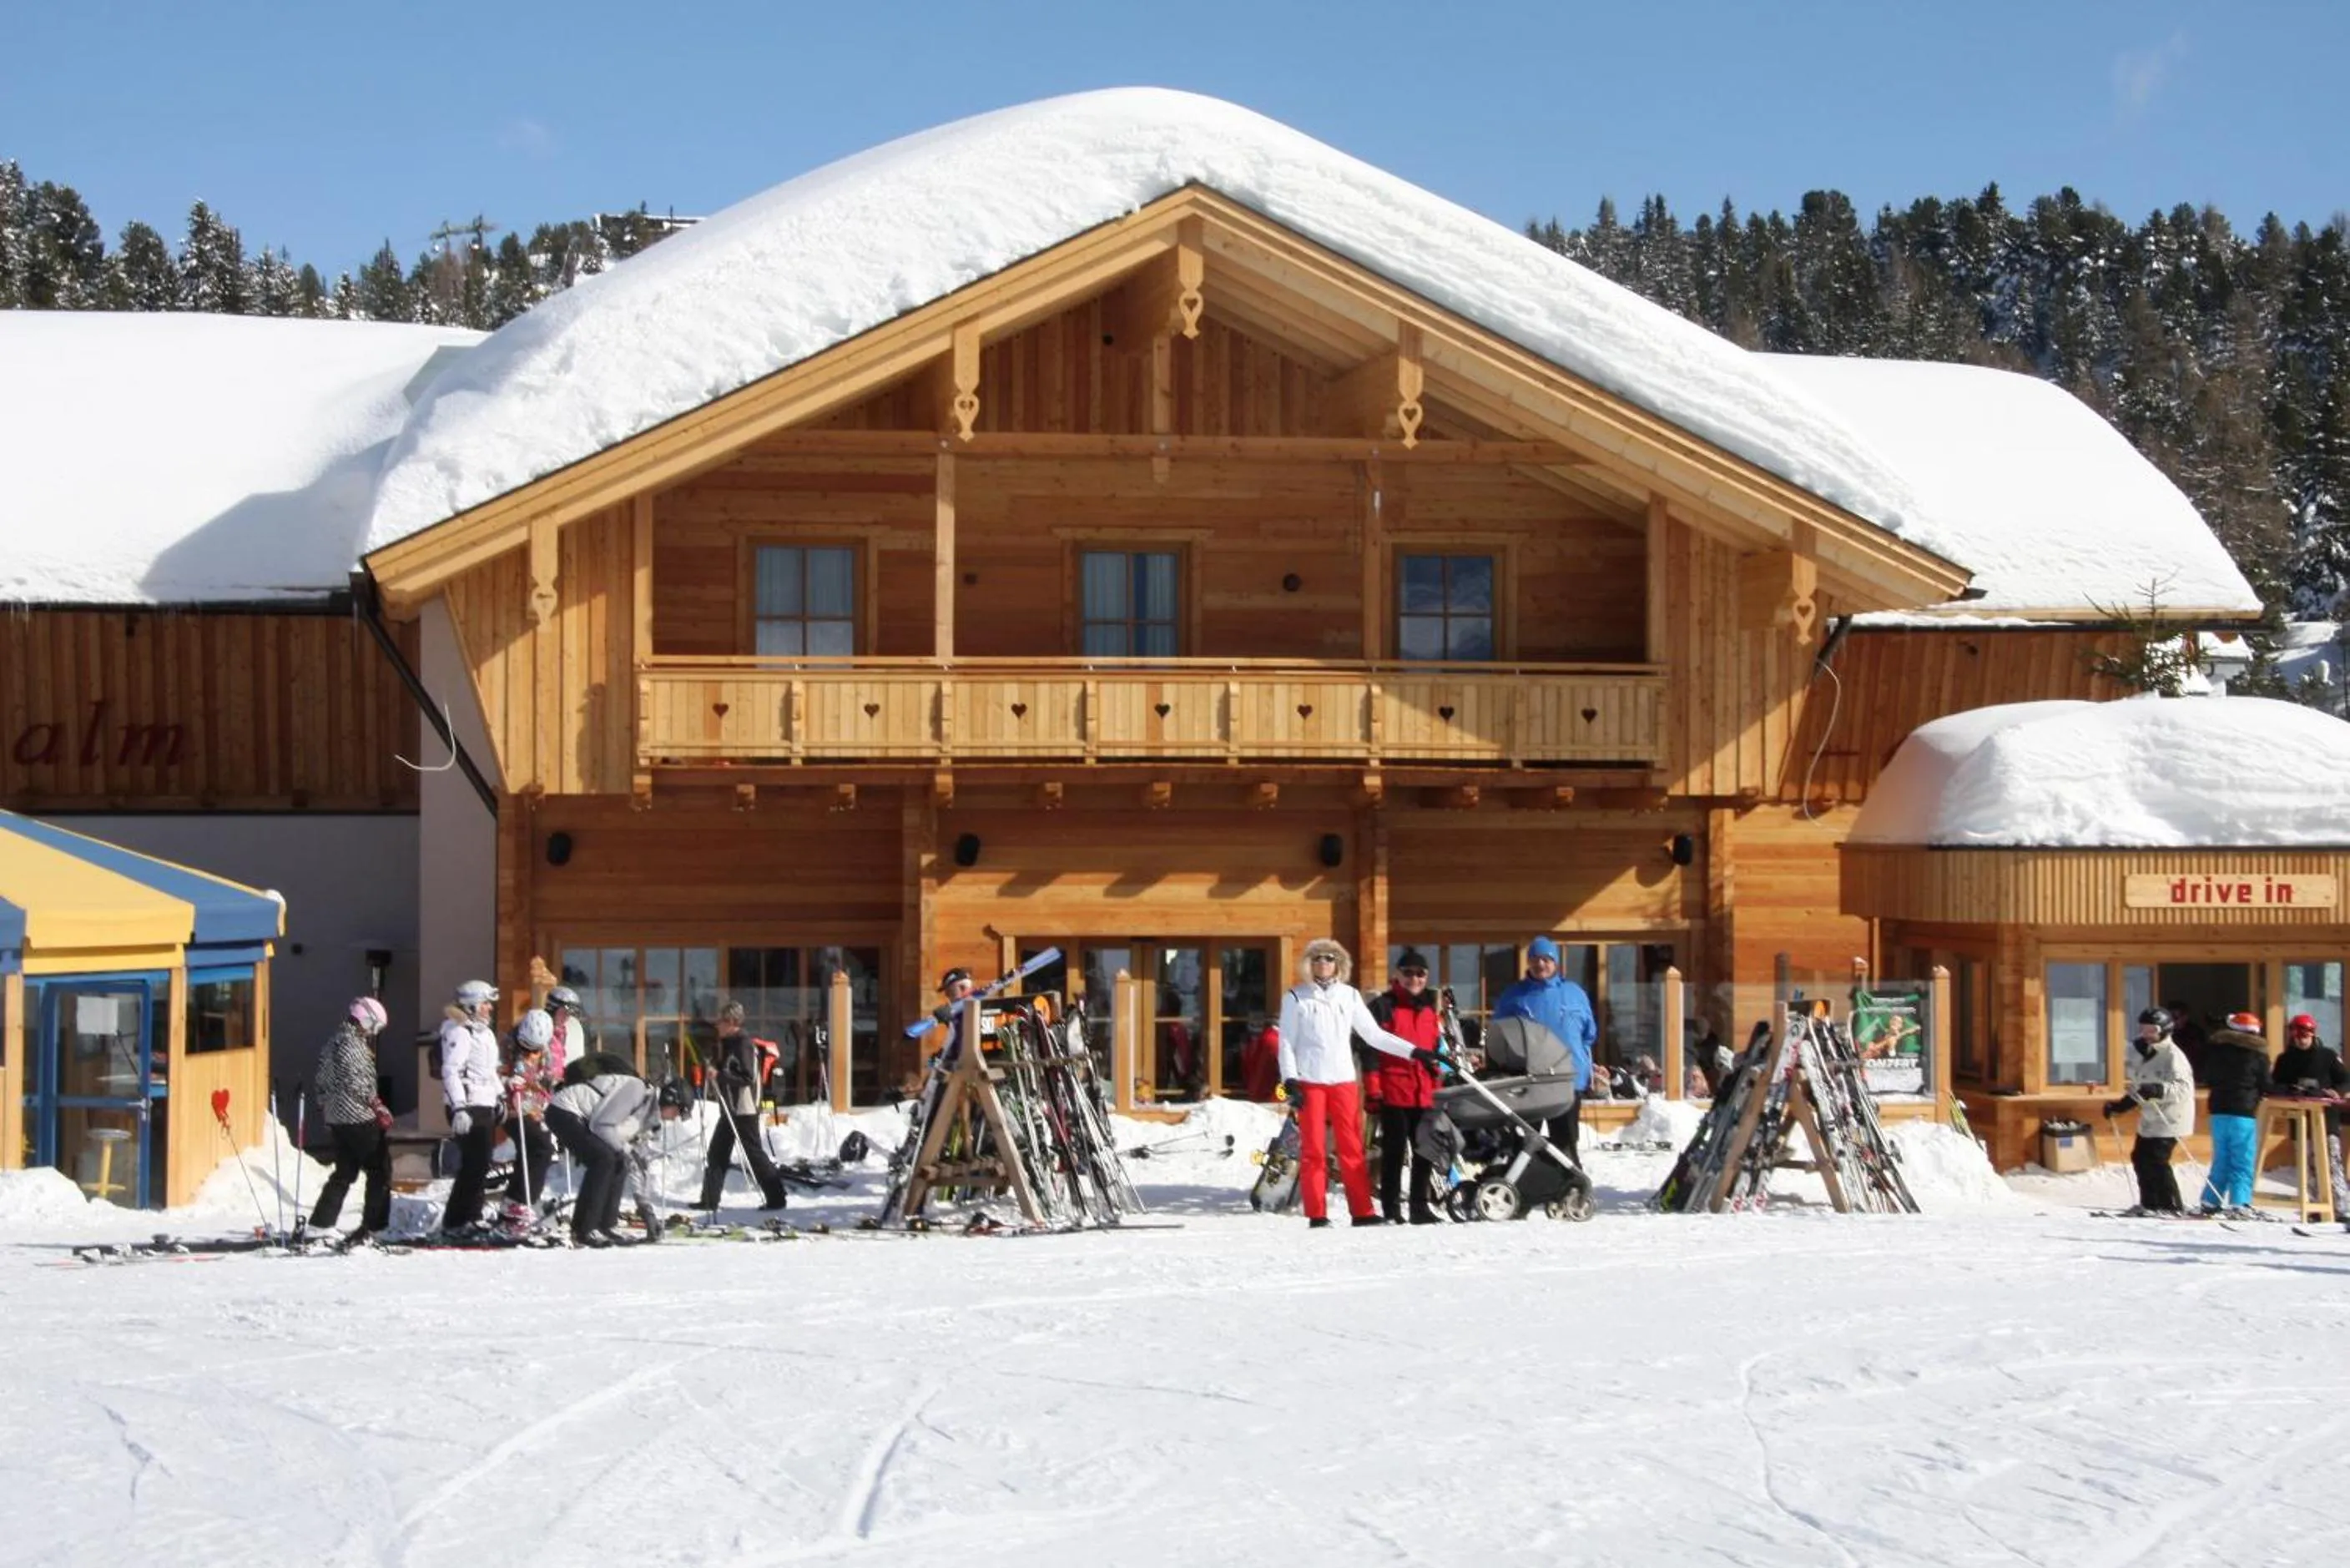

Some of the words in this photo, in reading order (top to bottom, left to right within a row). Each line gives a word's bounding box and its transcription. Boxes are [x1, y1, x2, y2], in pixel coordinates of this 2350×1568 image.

[13, 699, 185, 767] alm
[2171, 876, 2252, 903] drive
[2265, 876, 2292, 903] in
